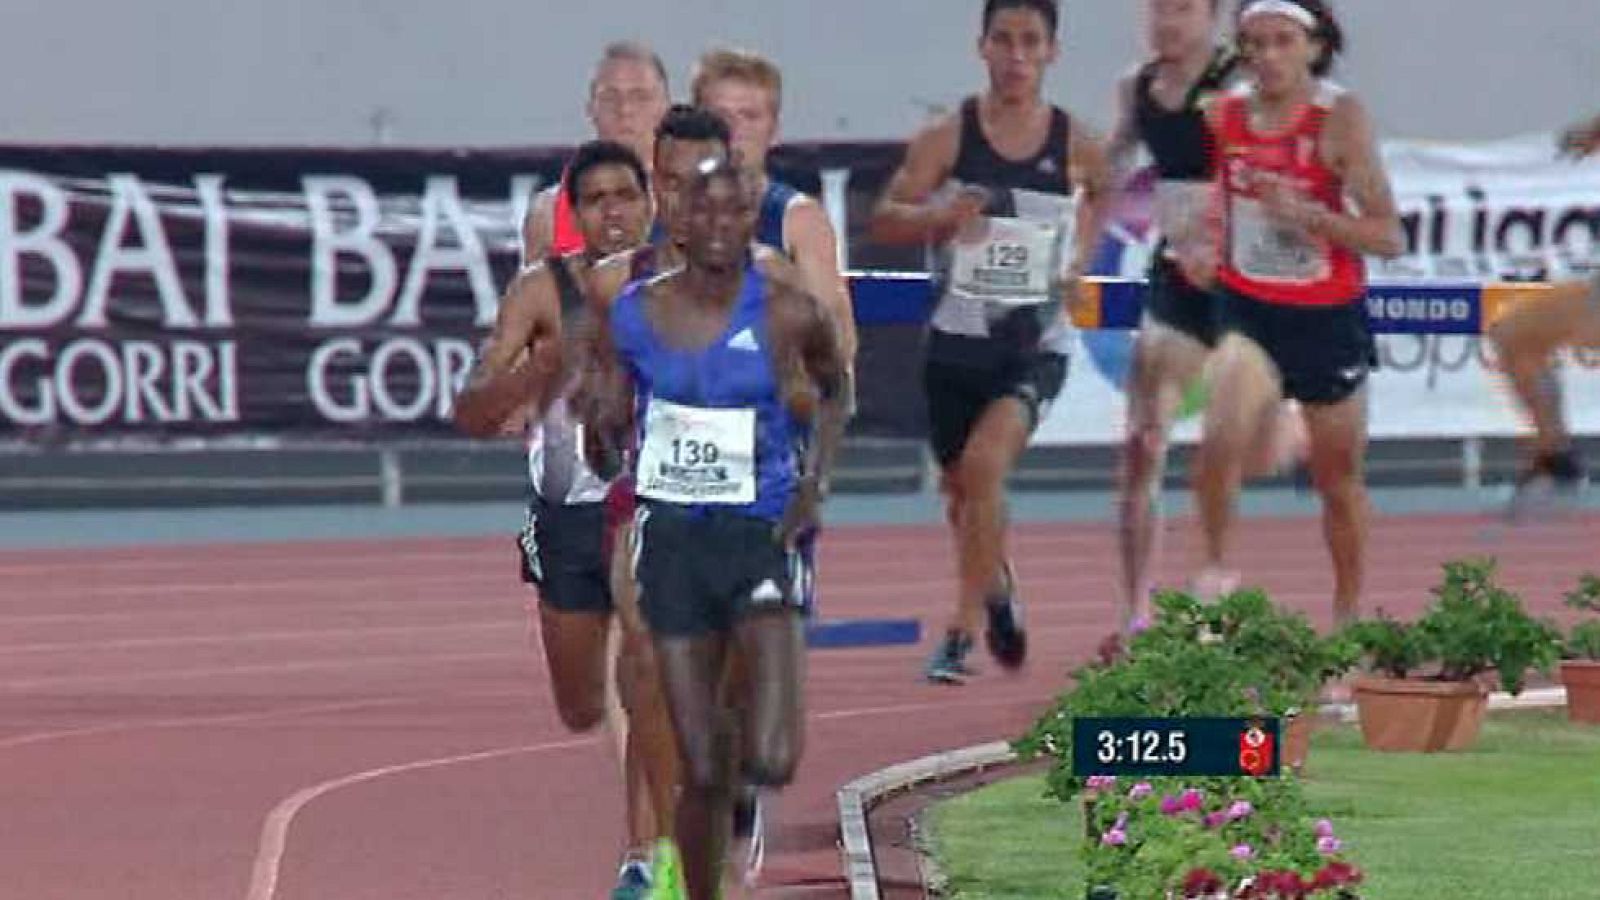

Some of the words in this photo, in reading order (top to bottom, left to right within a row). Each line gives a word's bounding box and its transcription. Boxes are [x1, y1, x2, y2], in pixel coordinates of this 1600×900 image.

[0, 170, 234, 328] BAI
[1368, 296, 1470, 321] MONDO
[0, 337, 240, 424] GORRI
[307, 336, 475, 422] GOR
